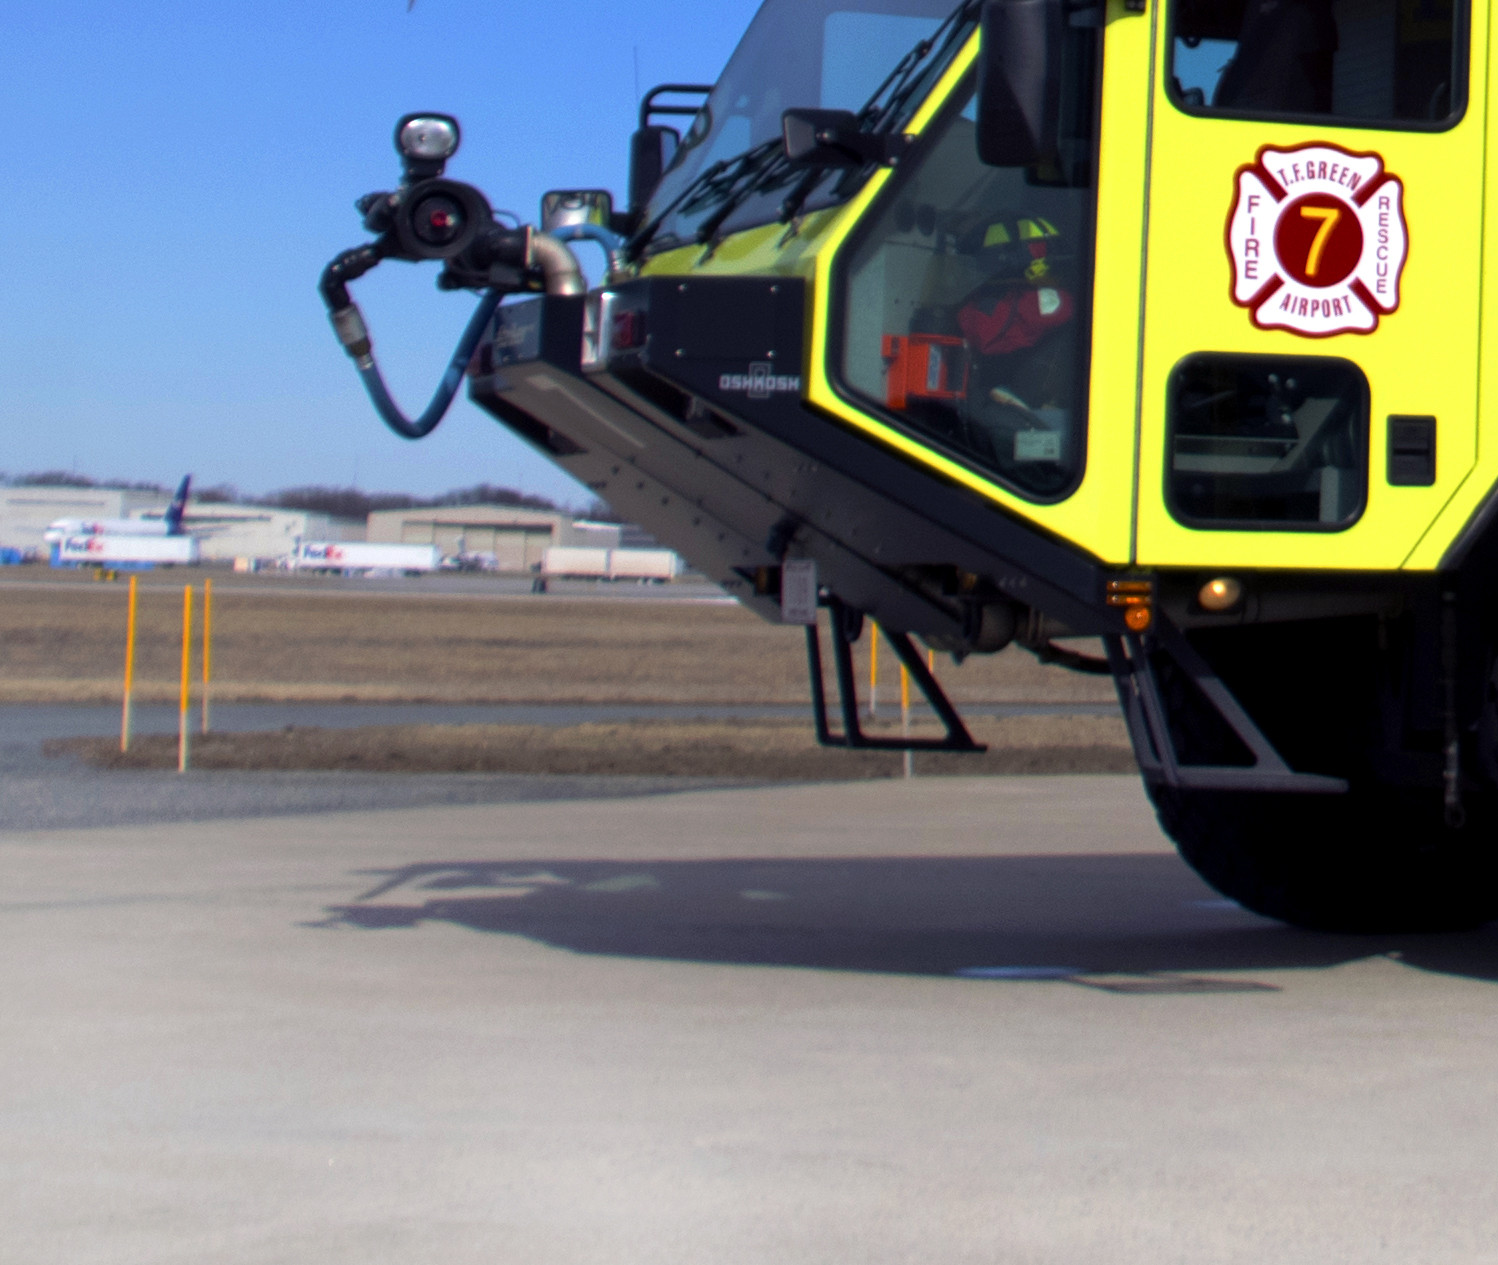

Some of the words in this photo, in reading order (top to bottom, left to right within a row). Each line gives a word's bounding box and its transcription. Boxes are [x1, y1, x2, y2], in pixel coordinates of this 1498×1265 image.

[1244, 194, 1261, 280] FIRE
[1299, 205, 1342, 277] 7
[1376, 195, 1390, 294] RESCUE
[1279, 293, 1352, 318] AIRPORT
[719, 373, 801, 391] OSHKOSH
[64, 537, 104, 553] FedEx
[303, 544, 343, 560] FedEx
